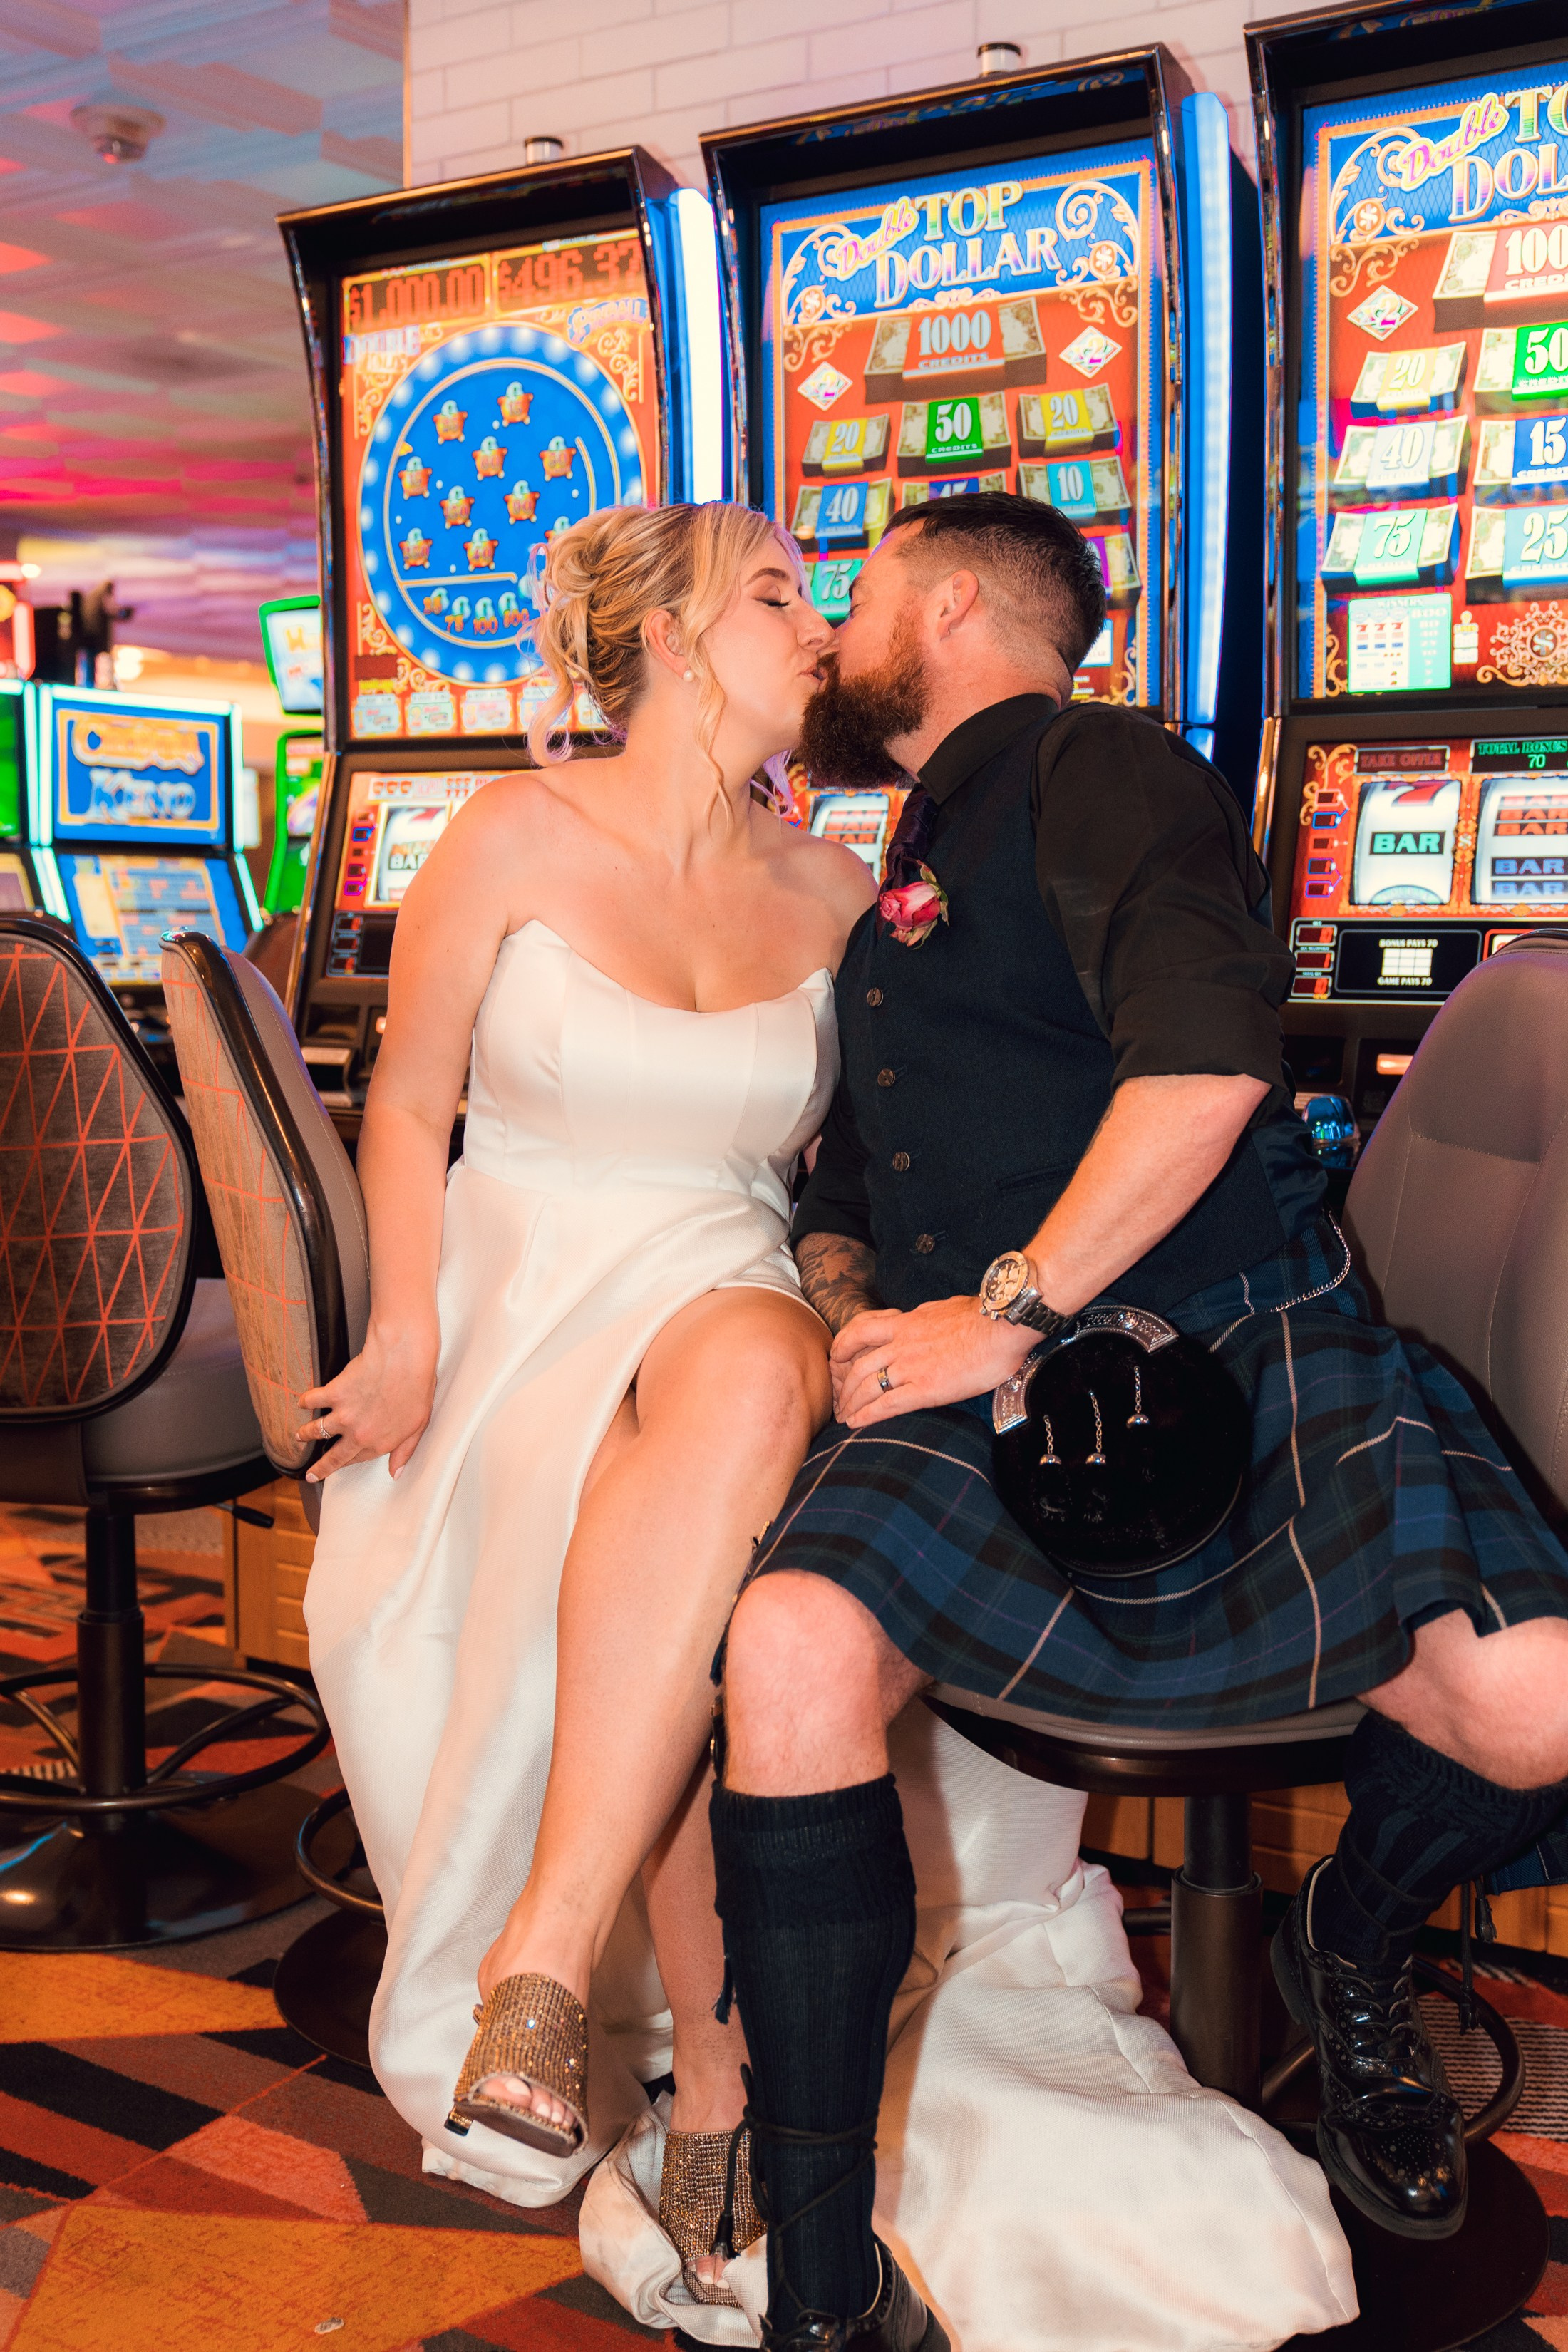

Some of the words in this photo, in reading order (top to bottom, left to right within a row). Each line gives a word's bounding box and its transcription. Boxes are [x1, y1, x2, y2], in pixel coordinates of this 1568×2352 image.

[1400, 97, 1505, 185] Double
[834, 198, 918, 278] Double
[914, 181, 1023, 241] TOP
[499, 239, 642, 306] $496.37
[874, 227, 1063, 308] DOLLAR
[349, 264, 485, 331] $1,000.00
[343, 324, 421, 365] DOUBLE
[917, 309, 992, 356] 1000
[1524, 327, 1568, 374] 50
[917, 351, 989, 370] CREDITS
[1388, 353, 1426, 391] 20
[934, 401, 973, 443] 50
[1049, 393, 1078, 428] 20
[830, 421, 860, 453] 20
[930, 443, 979, 454] CREDITS
[1380, 426, 1425, 470] 40
[1529, 416, 1567, 466] 15
[1056, 464, 1084, 502] 10
[825, 485, 860, 523] 40
[1373, 511, 1418, 559] 75
[1520, 507, 1568, 563] 25
[821, 559, 855, 600] 75
[1360, 753, 1396, 768] TAKE
[1399, 752, 1443, 766] OFFER
[1527, 753, 1547, 769] 70
[1373, 832, 1440, 854] BAR
[1497, 822, 1568, 836] BAR
[1495, 859, 1565, 875] BAR
[1379, 939, 1405, 949] BONUS
[1406, 939, 1426, 948] PAYS
[1426, 939, 1438, 948] 70
[1377, 977, 1400, 986] GAME
[1401, 977, 1421, 986] PAYS
[1420, 977, 1433, 986] 70
